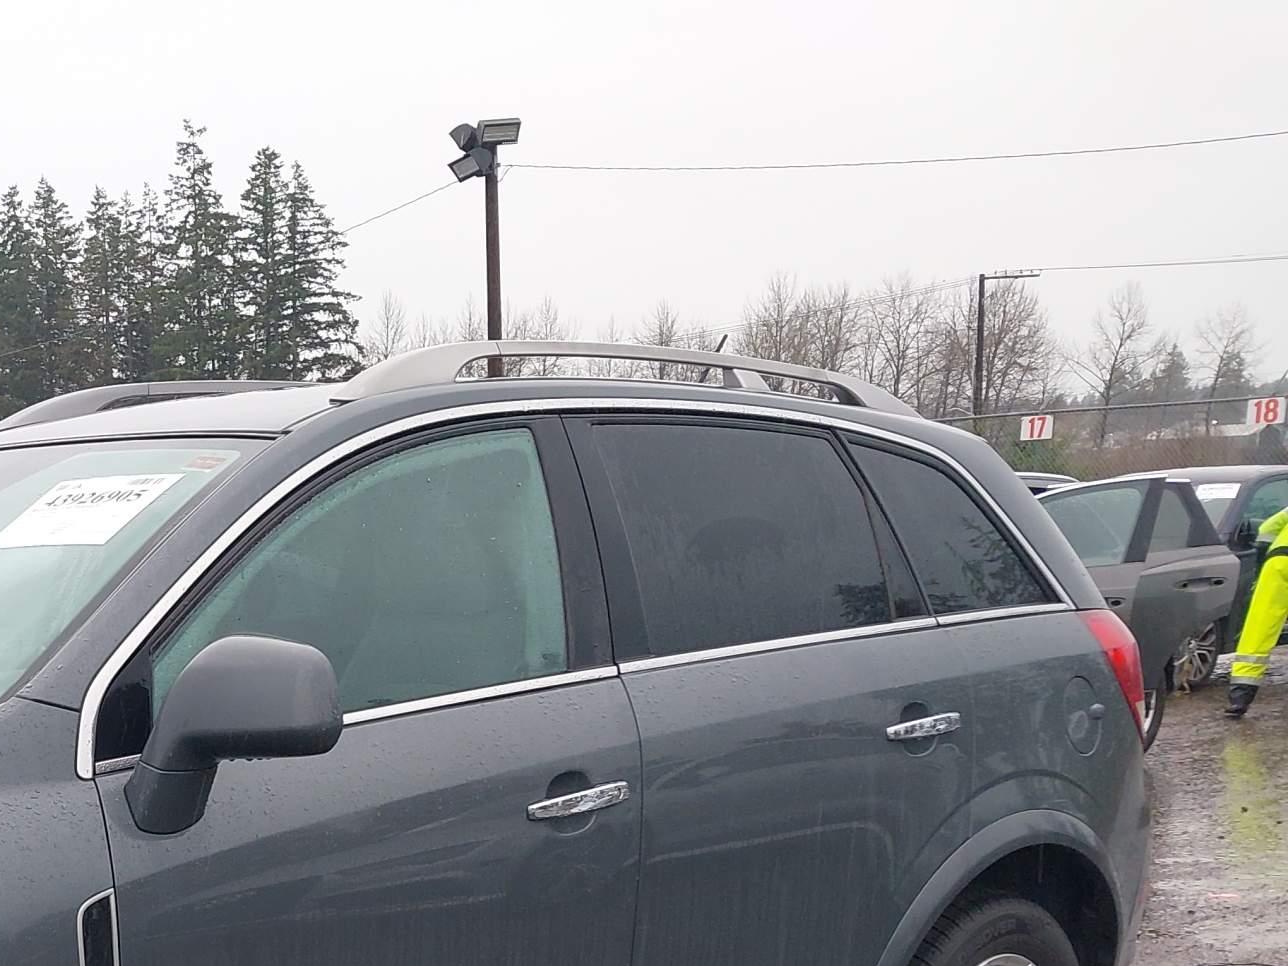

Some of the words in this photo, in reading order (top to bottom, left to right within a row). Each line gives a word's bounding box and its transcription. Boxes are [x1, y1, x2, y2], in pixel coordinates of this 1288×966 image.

[1254, 398, 1279, 424] 18
[1027, 416, 1047, 438] 17
[46, 489, 147, 506] 43926905
